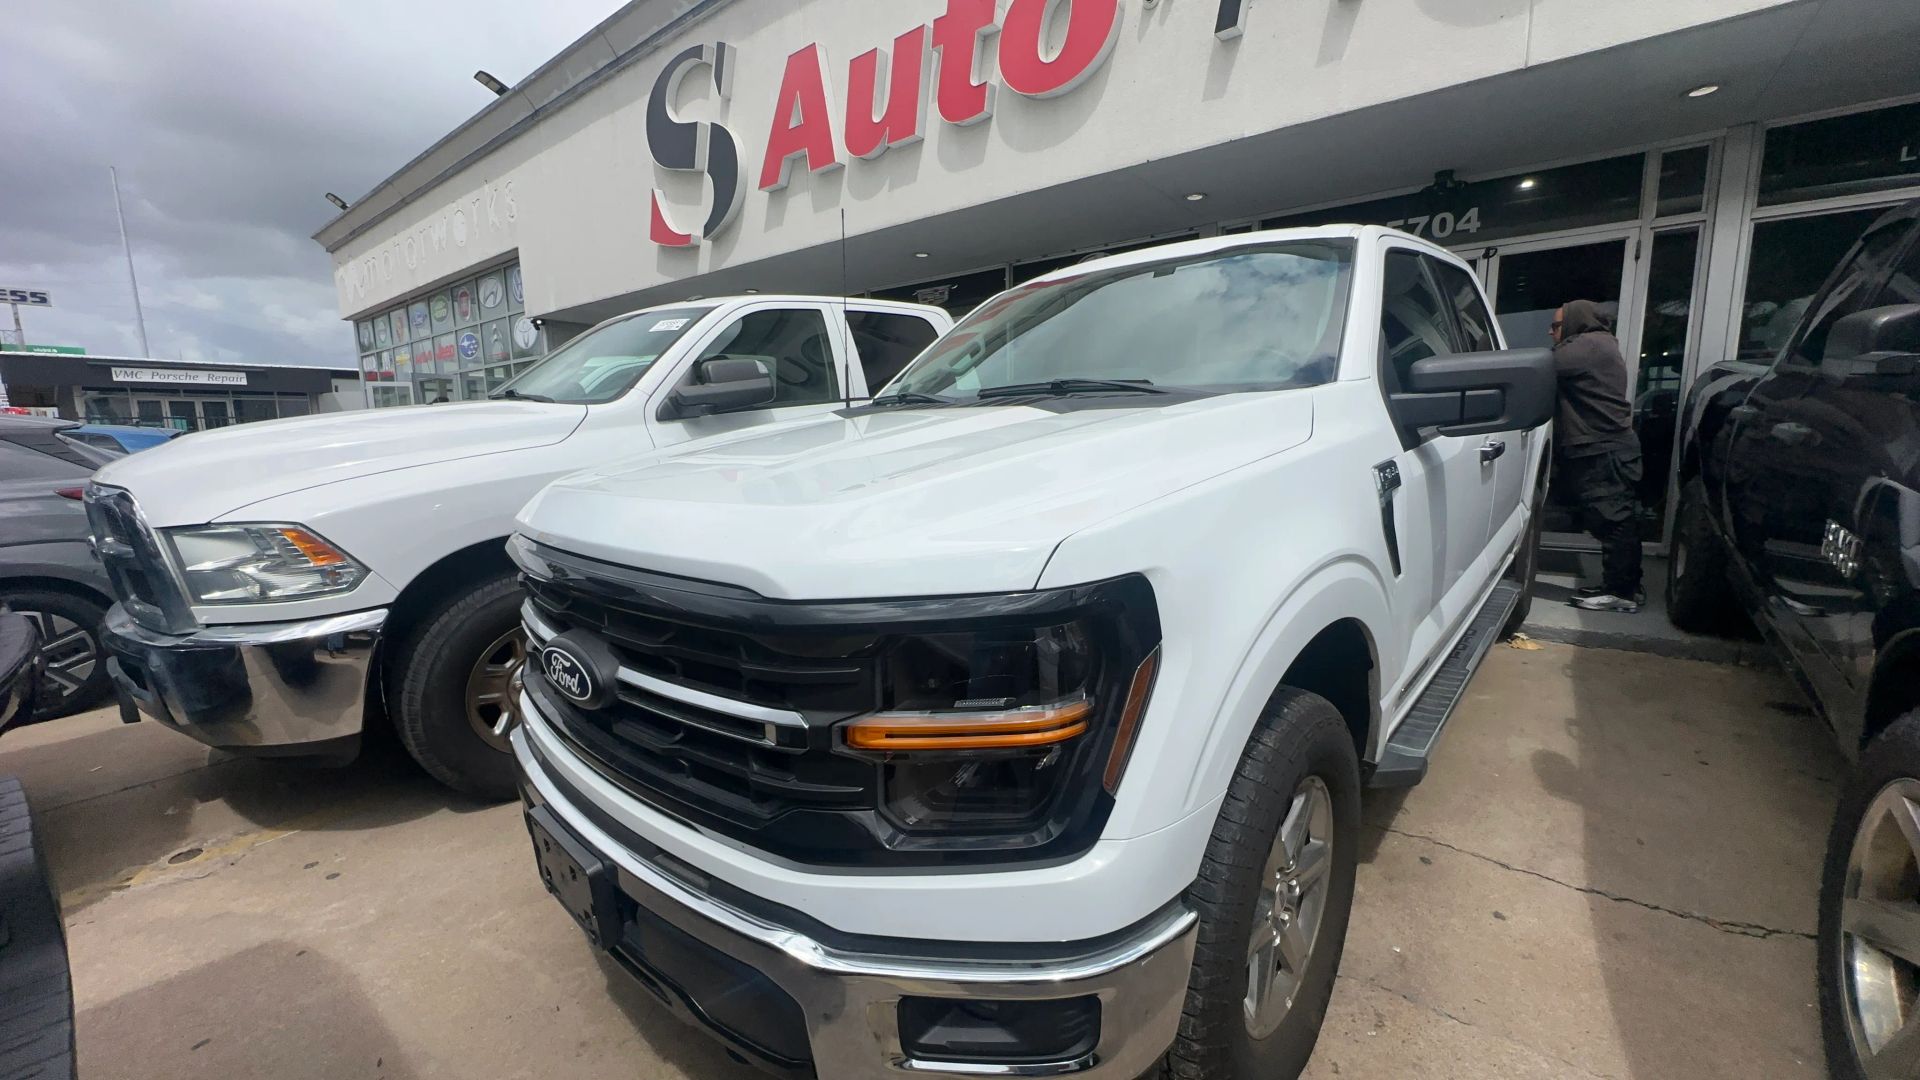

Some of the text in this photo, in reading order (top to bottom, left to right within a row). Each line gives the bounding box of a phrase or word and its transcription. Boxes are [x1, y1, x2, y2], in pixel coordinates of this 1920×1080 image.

[758, 0, 1124, 192] Auto
[114, 370, 246, 384] VMC Porsche Repair
[551, 653, 580, 694] Ford
